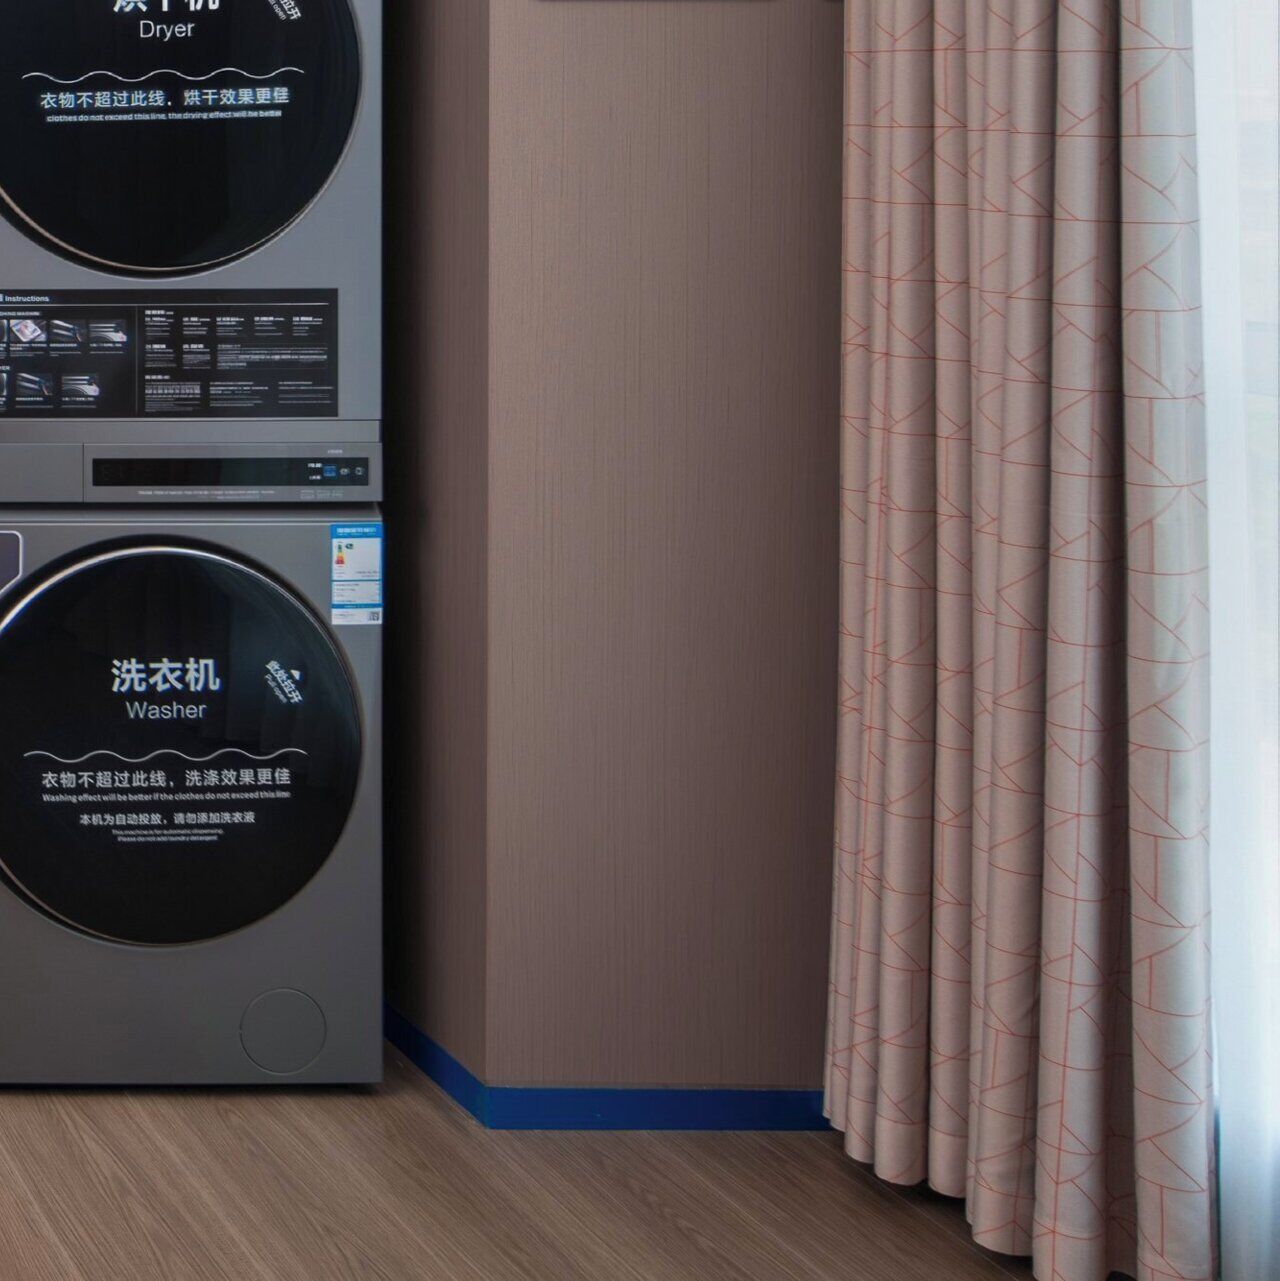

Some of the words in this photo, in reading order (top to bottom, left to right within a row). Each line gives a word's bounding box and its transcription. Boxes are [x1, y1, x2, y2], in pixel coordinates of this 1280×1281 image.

[273, 4, 286, 20] open
[139, 20, 195, 42] Dryer
[111, 657, 221, 693] 洗衣机
[125, 701, 207, 719] Washer
[41, 767, 291, 788] 衣物不超过此线，洗涤效果更佳
